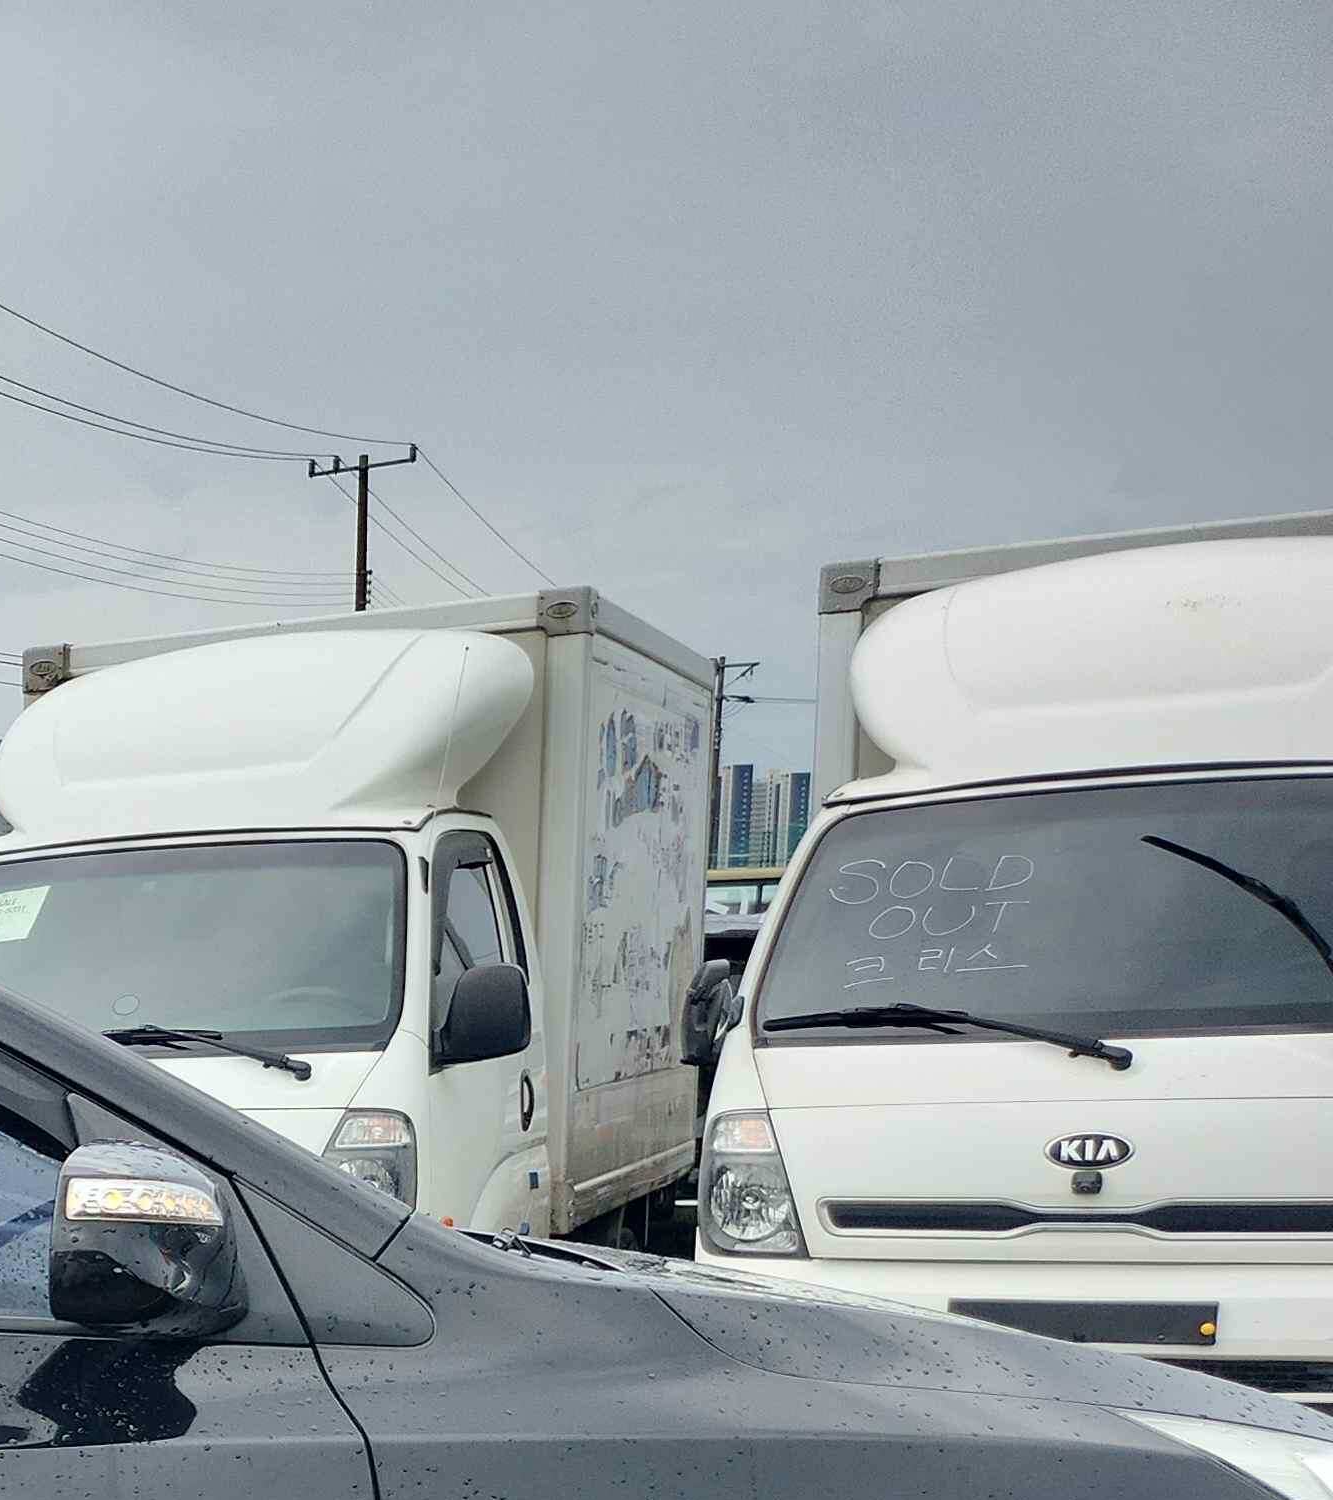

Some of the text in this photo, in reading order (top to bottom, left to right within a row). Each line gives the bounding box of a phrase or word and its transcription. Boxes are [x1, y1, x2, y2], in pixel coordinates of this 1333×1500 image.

[829, 855, 1034, 904] SOLD
[869, 901, 1030, 939] OUT
[1060, 1139, 1120, 1161] KIA
